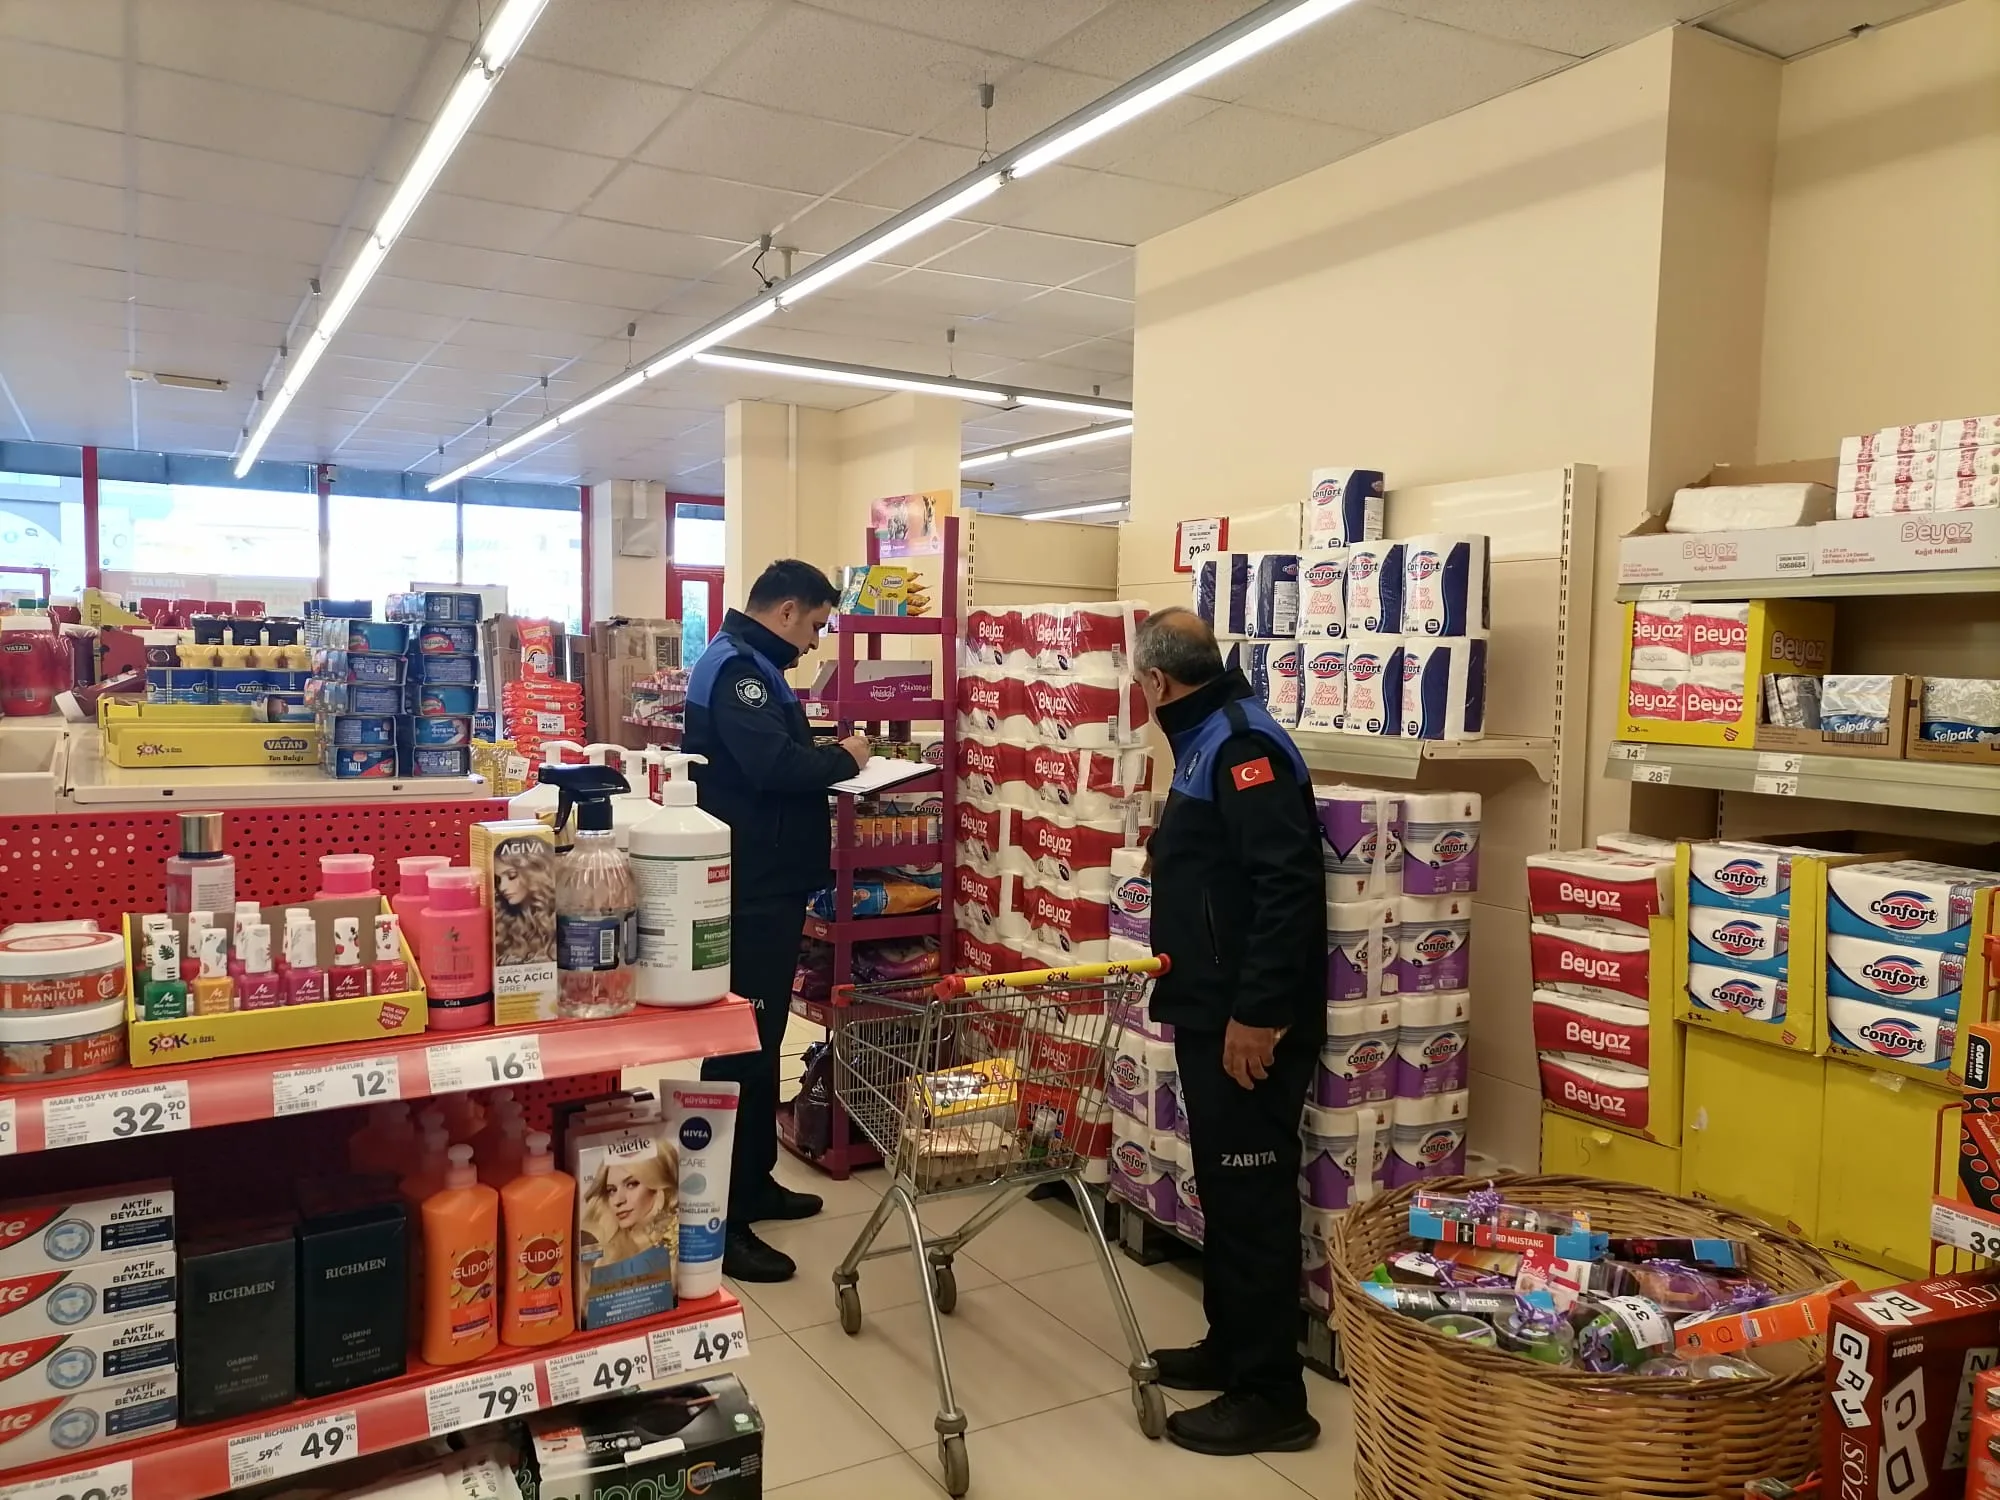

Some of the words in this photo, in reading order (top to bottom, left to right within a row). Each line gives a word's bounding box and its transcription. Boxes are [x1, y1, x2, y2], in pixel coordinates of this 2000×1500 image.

[1312, 488, 1342, 498] Confort
[1901, 522, 1973, 544] Beyaz
[1683, 541, 1738, 561] Beyaz
[1304, 571, 1344, 581] Confort
[979, 621, 1005, 641] Beyaz
[1037, 624, 1071, 644] Beyaz
[1634, 621, 1684, 641] Beyaz
[1771, 631, 1824, 667] Beyaz
[1348, 663, 1382, 673] Confort
[1315, 682, 1336, 694] Dev
[1311, 694, 1340, 706] Havlu
[1834, 718, 1870, 733] Selpak
[1934, 728, 1973, 742] Selpak
[267, 741, 303, 750] VATAN
[967, 749, 995, 770] Beyaz
[1626, 749, 1639, 760] 14
[1035, 759, 1065, 777] Beyaz
[1784, 761, 1793, 771] 9
[1648, 771, 1662, 782] 28
[1775, 782, 1789, 794] 12
[961, 812, 988, 836] Beyaz
[501, 842, 544, 855] AGIVA
[1039, 829, 1072, 853] Beyaz
[1433, 841, 1468, 855] Confort
[1714, 870, 1767, 886] Confort
[961, 876, 988, 899] Beyaz
[1560, 882, 1620, 908] Beyaz
[1118, 887, 1151, 904] Confor
[1038, 899, 1072, 924] Beyaz
[1870, 900, 1937, 922] Confort
[1416, 940, 1455, 953] Confort
[1712, 930, 1765, 949] Confort
[964, 941, 992, 968] Beyaz
[1561, 951, 1620, 979] Beyaz
[498, 974, 521, 984] SAÇ
[524, 972, 554, 981] AÇICI
[1862, 965, 1928, 988] Confort
[23, 988, 84, 1003] MANİKÜR
[498, 985, 528, 993] SPREY
[1711, 987, 1764, 1008] Confort
[1566, 1022, 1631, 1050] Beyaz
[1860, 1026, 1926, 1051] Confort
[1423, 1042, 1458, 1056] Confort
[1347, 1051, 1385, 1065] Confort
[1113, 1061, 1140, 1086] Confort
[49, 1098, 75, 1106] MARA
[78, 1094, 106, 1102] KOLAY
[1564, 1081, 1625, 1111] Beyaz
[169, 1112, 182, 1120] TL
[683, 1130, 709, 1138] NIVEA
[1420, 1140, 1454, 1156] Confort
[679, 1158, 706, 1168] CARE
[1221, 1151, 1277, 1167] ZABITA
[121, 1198, 153, 1210] AKTİF
[110, 1206, 163, 1221] BEYAZLIK
[1486, 1233, 1505, 1243] FRD
[1507, 1236, 1543, 1248] MUSTANG
[123, 1261, 155, 1273] AKTİF
[326, 1257, 387, 1279] RICHMEN
[113, 1268, 165, 1283] BEYAZLIK
[208, 1281, 276, 1303] RICHMEN
[1920, 1280, 1962, 1294] OYUNU
[123, 1323, 155, 1336] AKTİF
[652, 1330, 675, 1339] PALETTE
[113, 1330, 164, 1346] BEYAZLIK
[734, 1341, 742, 1349] TL
[1840, 1333, 1862, 1360] G
[550, 1356, 574, 1365] PALETTE
[637, 1366, 645, 1374] TL
[1845, 1369, 1864, 1391] R
[126, 1382, 157, 1395] AKTİF
[115, 1388, 166, 1406] BEYAZLIK
[523, 1395, 532, 1403] TL
[1841, 1398, 1862, 1415] J
[1896, 1389, 1917, 1431] C
[264, 1425, 299, 1438] RICHMEN
[317, 1418, 328, 1426] ML
